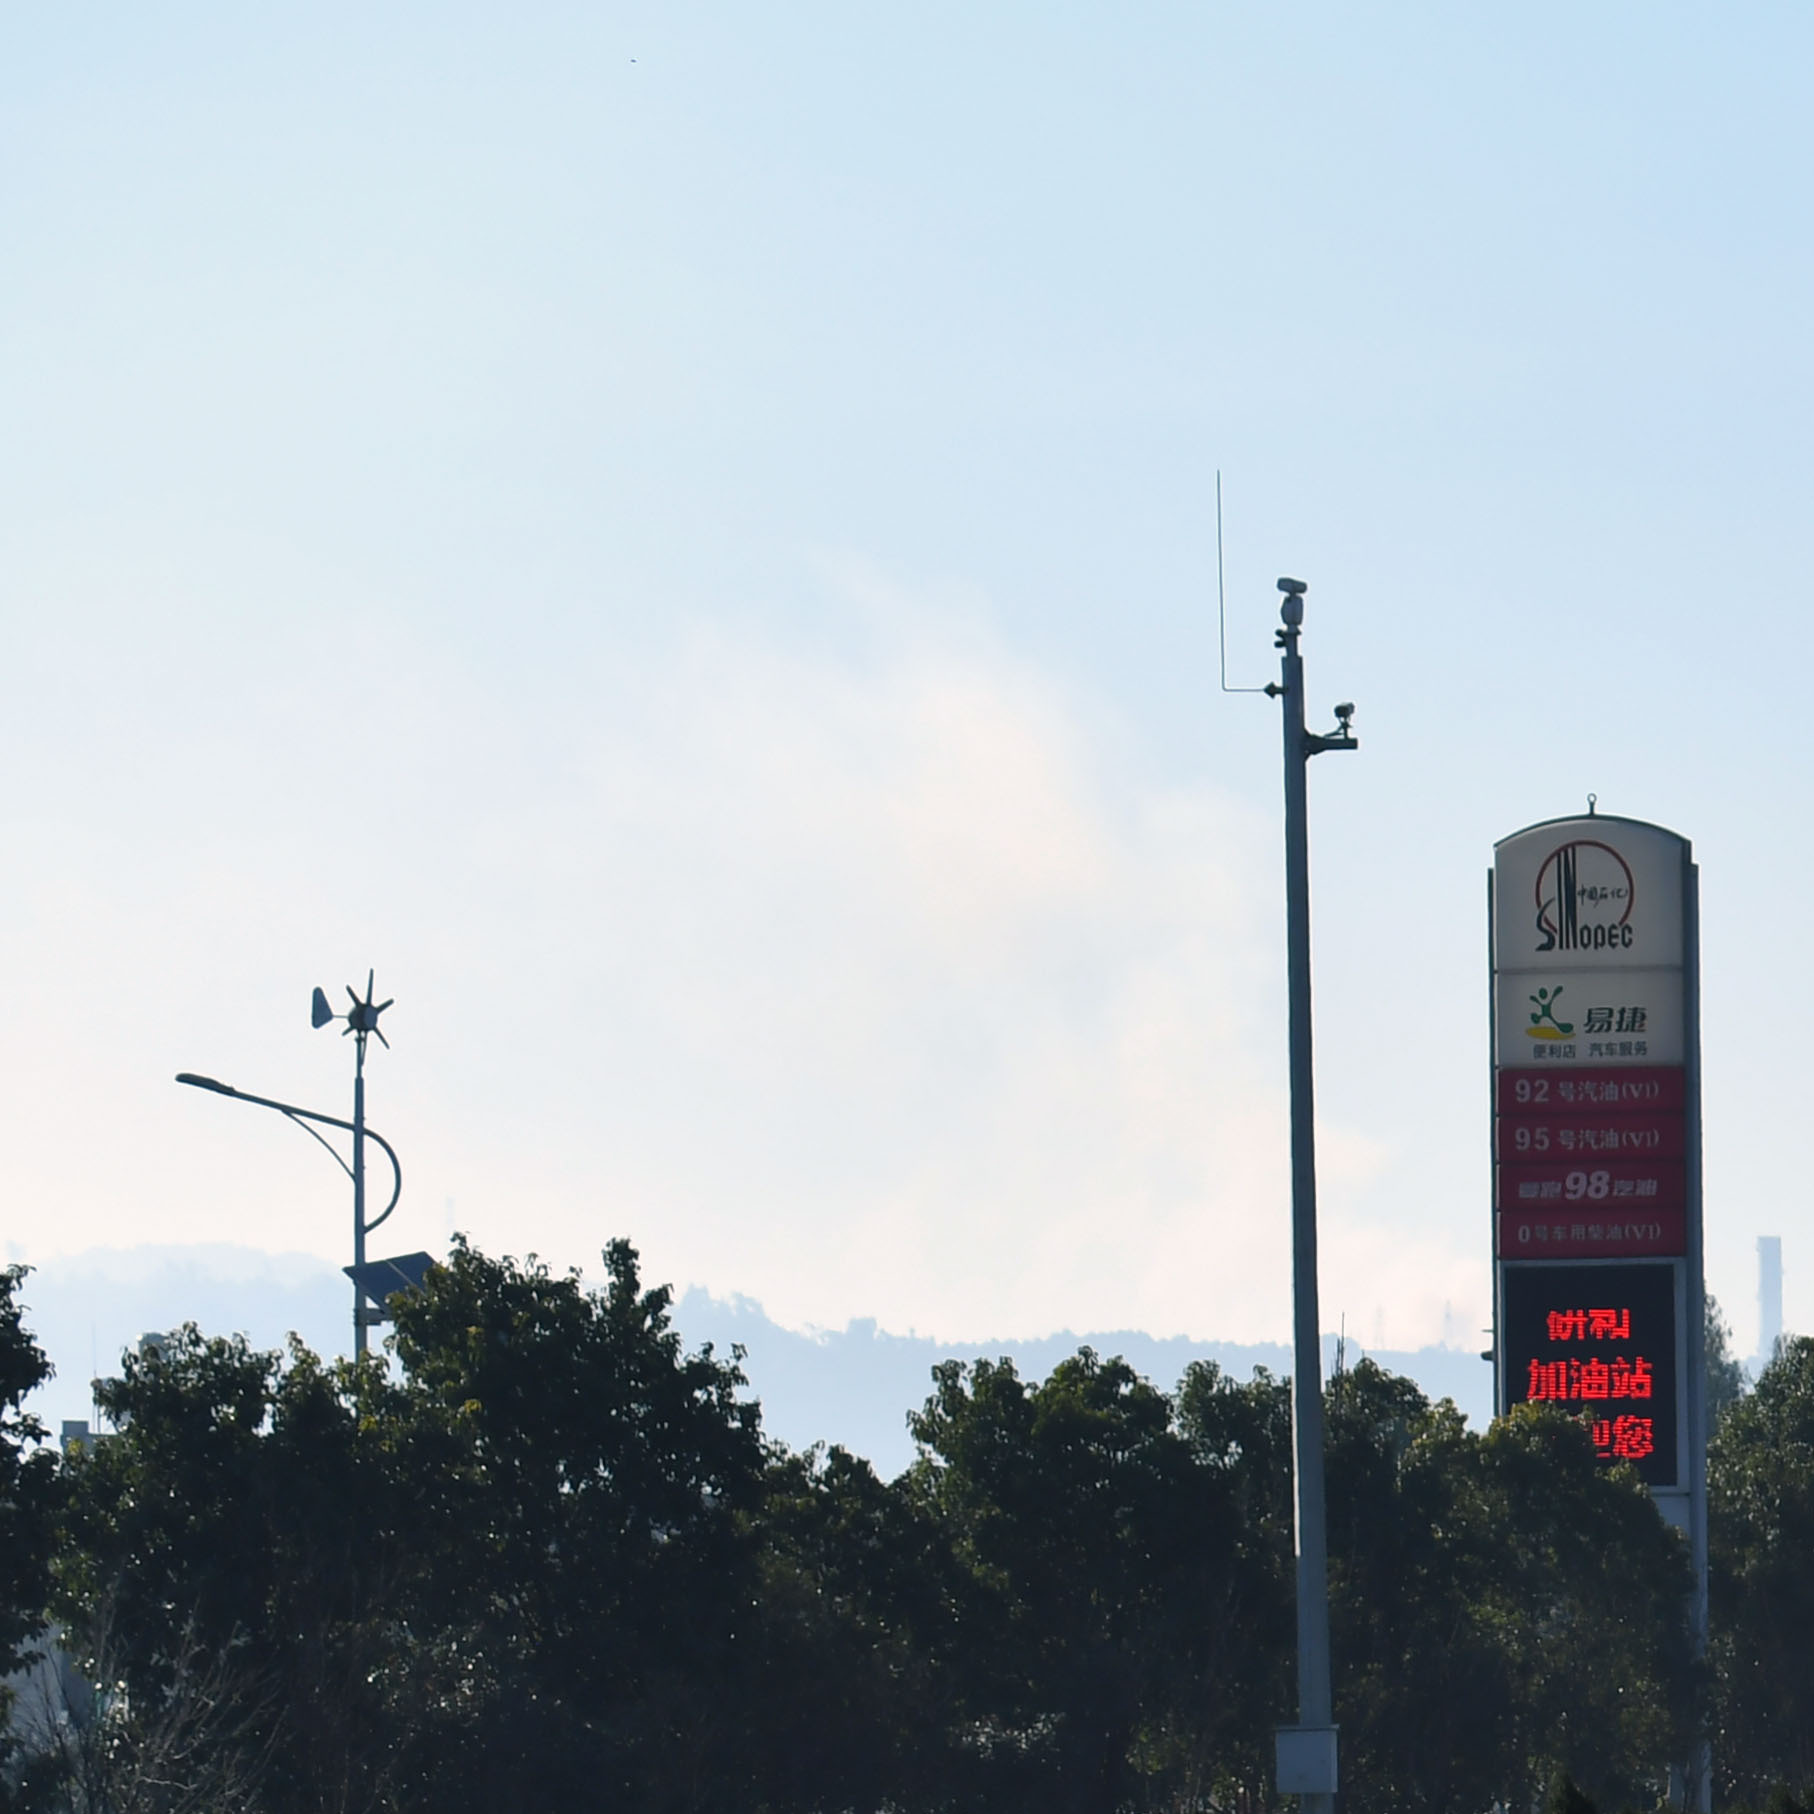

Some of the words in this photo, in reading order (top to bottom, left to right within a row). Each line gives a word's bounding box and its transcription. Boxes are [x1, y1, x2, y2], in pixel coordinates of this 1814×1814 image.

[1583, 1006, 1648, 1034] 易捷
[1533, 1043, 1577, 1059] 便利店
[1588, 1041, 1648, 1057] 汽车服务
[1527, 1356, 1653, 1400] 加油站
